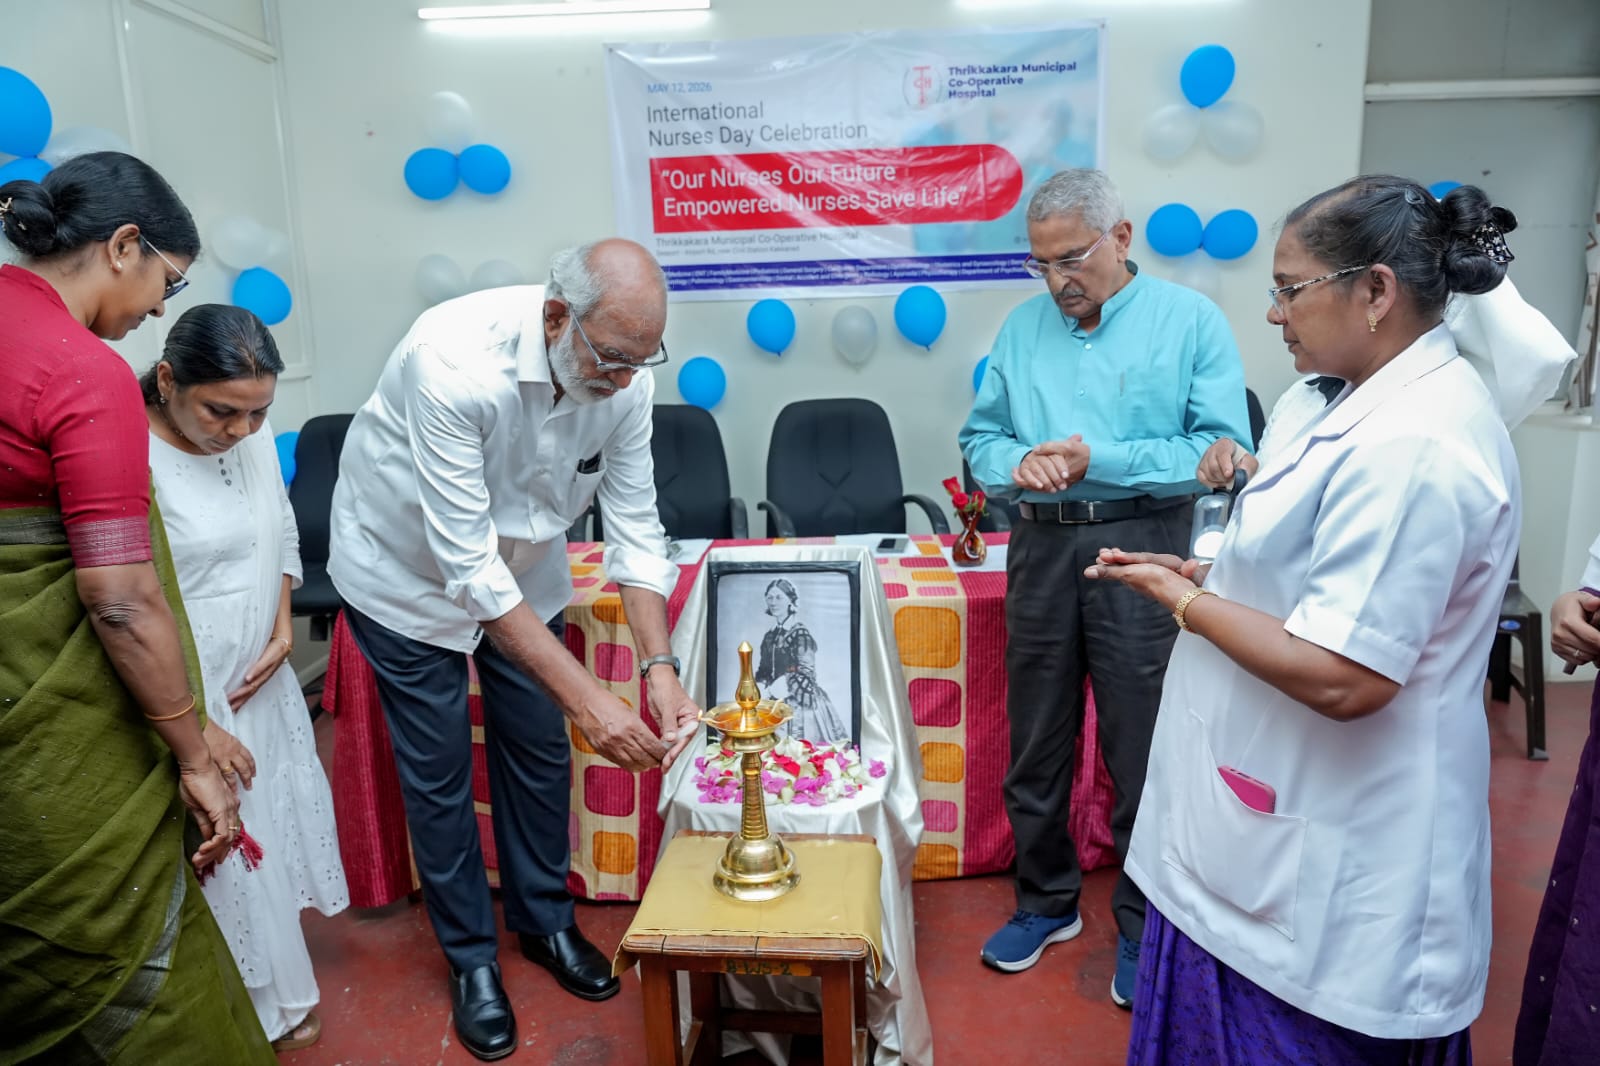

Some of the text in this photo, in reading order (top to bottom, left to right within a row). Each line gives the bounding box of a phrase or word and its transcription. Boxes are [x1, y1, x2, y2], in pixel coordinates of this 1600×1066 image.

[948, 62, 1077, 76] Thrikkakara Municipal
[647, 83, 669, 94] MAY
[688, 81, 713, 93] 2026
[948, 76, 1024, 88] Co-Operative
[948, 88, 996, 99] Hospital
[647, 100, 764, 123] International
[649, 122, 868, 147] Nurses Day Celebration
[711, 167, 783, 188] Nurses
[788, 165, 824, 185] Our
[830, 163, 896, 184] Future
[663, 193, 783, 219] Empowered
[789, 191, 861, 212] Nurses
[866, 188, 918, 209] Save
[711, 235, 756, 247] Municipal
[758, 232, 817, 246] Co-Operative
